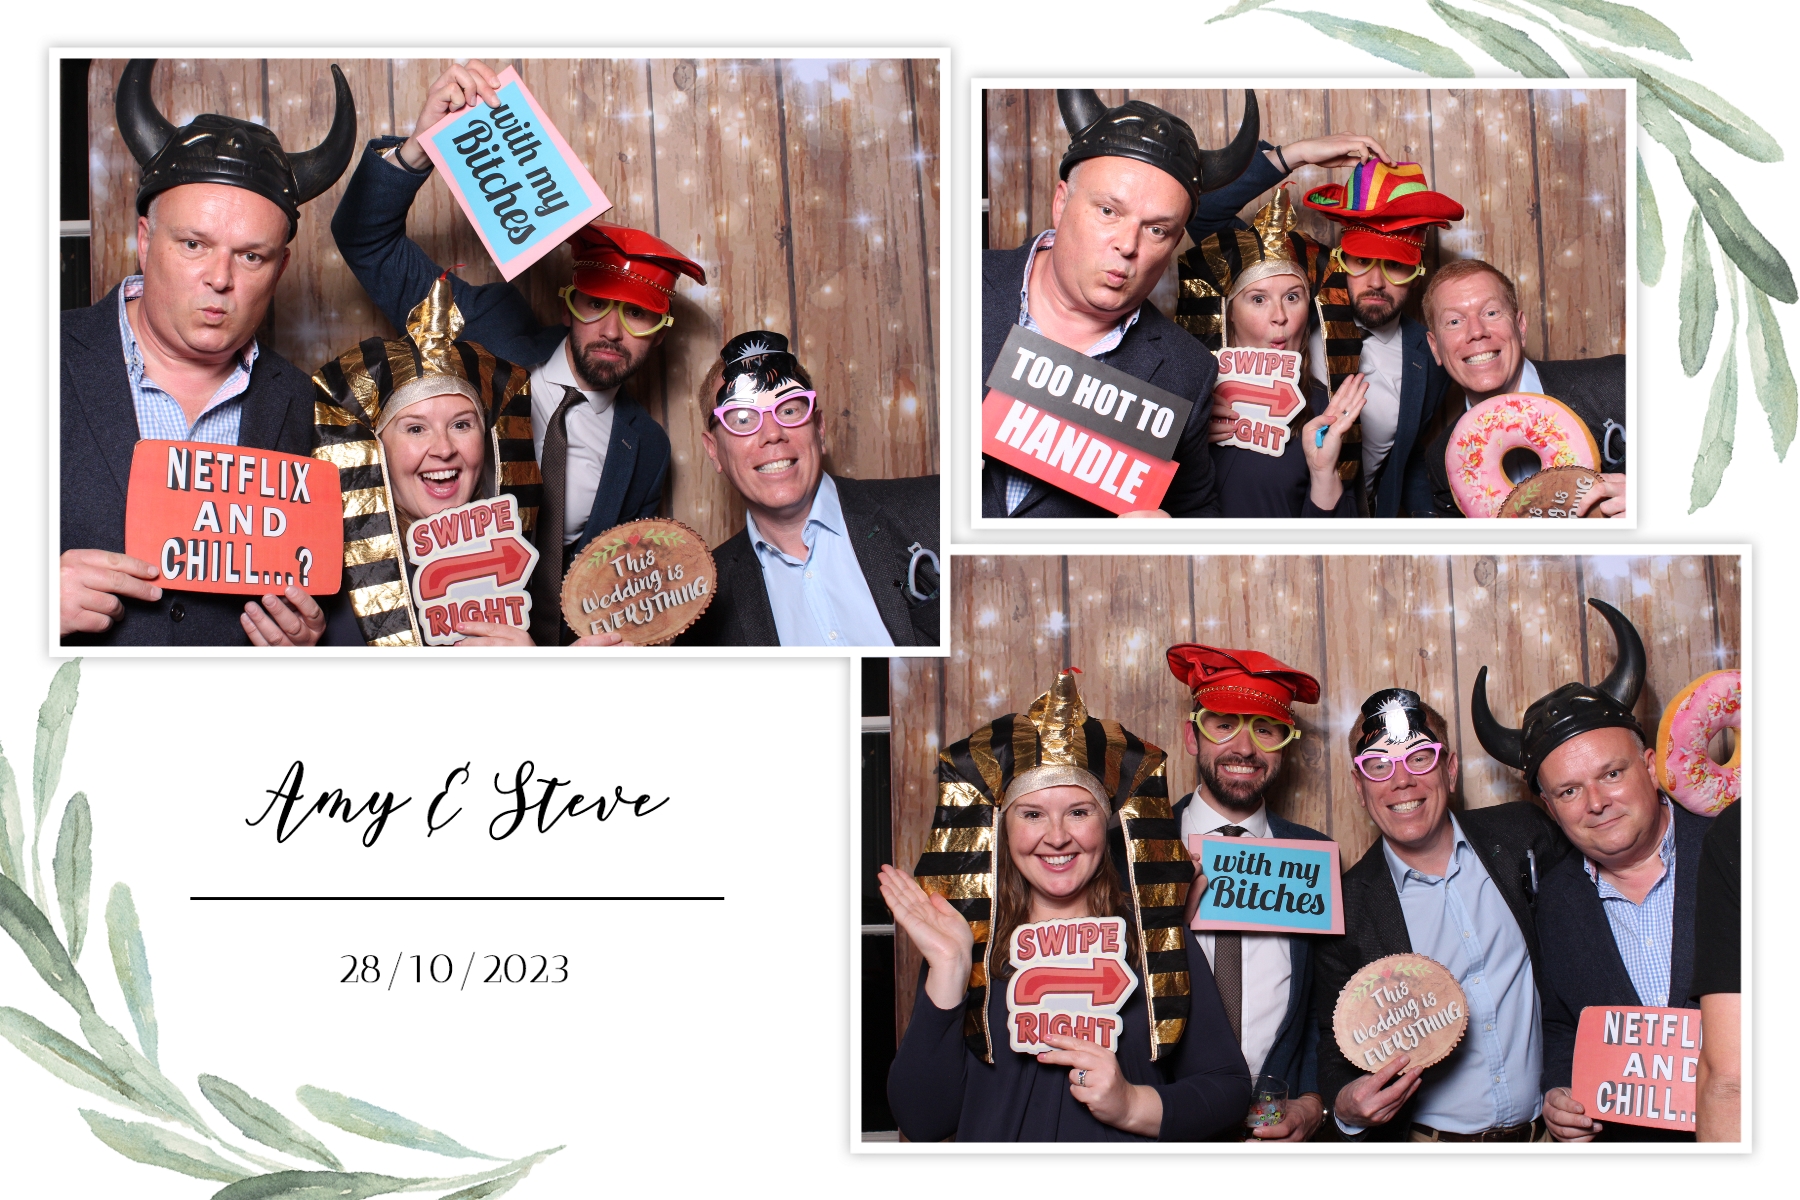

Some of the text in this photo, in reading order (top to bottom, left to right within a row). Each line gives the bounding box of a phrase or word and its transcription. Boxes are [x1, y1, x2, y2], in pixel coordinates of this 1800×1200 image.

[489, 103, 570, 217] with my
[452, 119, 537, 245] Bitches
[1218, 351, 1297, 379] SWIPE
[1011, 346, 1175, 439] TOO HOT TO
[994, 399, 1151, 505] HANDLE
[1212, 418, 1285, 450] GHT
[167, 446, 311, 504] NETFLIX
[192, 500, 287, 538] AND
[413, 500, 514, 557] SWIPE
[161, 537, 313, 587] CHILL...?
[610, 550, 656, 577] This
[582, 564, 684, 614] Wedding is
[590, 576, 710, 635] EVERYTHING
[425, 596, 525, 637] RIGHT
[1213, 850, 1321, 888] with my
[1209, 875, 1325, 915] Bitches
[1017, 922, 1120, 961] SWIPE
[1370, 981, 1409, 1008] This
[1015, 1012, 1116, 1049] RIGHT
[1352, 992, 1437, 1044] Wedding is
[1363, 1001, 1464, 1067] EVERYTHING
[1603, 1010, 1703, 1050] NETFL
[1622, 1052, 1699, 1083] AND
[1596, 1081, 1697, 1123] CHILL..
